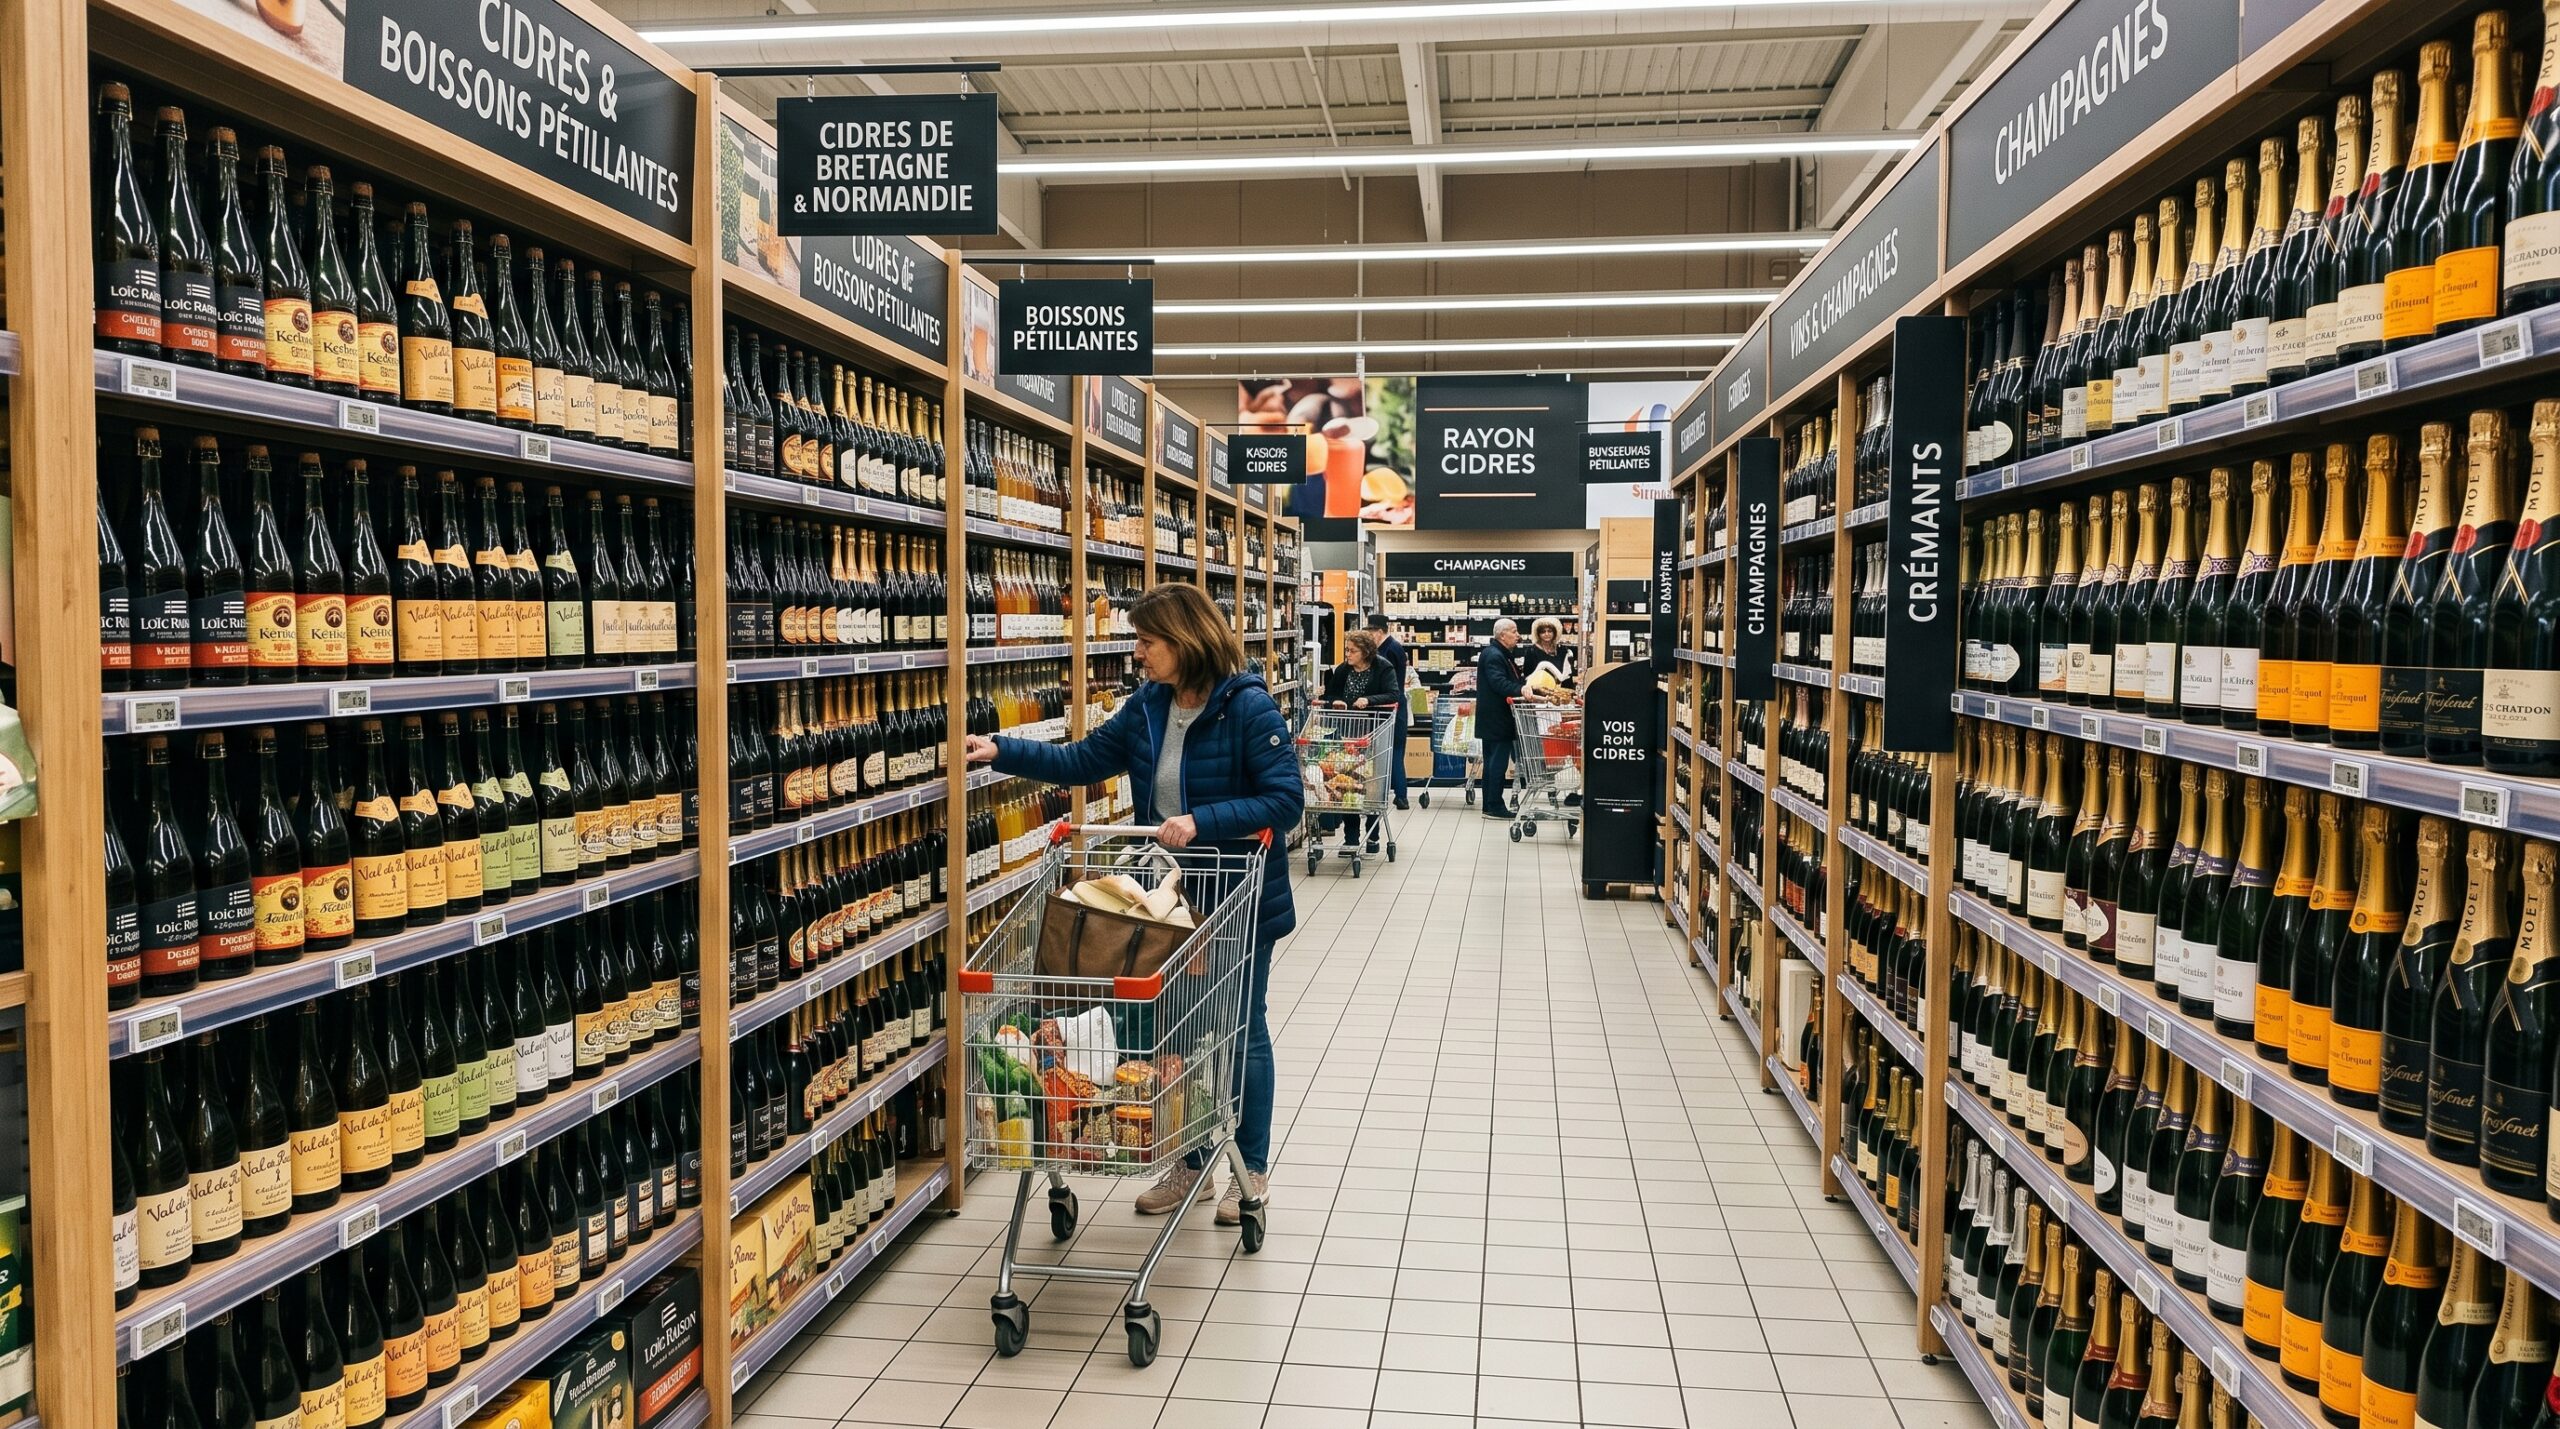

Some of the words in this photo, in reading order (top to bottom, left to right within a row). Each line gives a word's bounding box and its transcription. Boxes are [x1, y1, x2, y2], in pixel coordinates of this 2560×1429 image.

[478, 0, 591, 105] CIDRES
[598, 63, 619, 123] &
[1994, 0, 2169, 185] CHAMPAGNES
[380, 15, 532, 139] BOISSONS
[538, 101, 679, 213] PÉTILLANTES
[819, 122, 912, 150] CIDRES
[920, 120, 954, 147] DE
[817, 152, 949, 181] BRETAGNE
[793, 194, 808, 213] &
[813, 184, 973, 213] NORMANDIE
[852, 236, 900, 286] CIDRES
[813, 251, 875, 314] BOISSONS
[877, 286, 941, 346] PÉTILLANTES
[1790, 309, 1811, 360] VINS
[1810, 301, 1820, 342] &
[1820, 227, 1899, 334] CHAMPAGNES
[1026, 305, 1125, 327] BOISSONS
[1013, 328, 1139, 352] PÉTILLANTES
[1443, 427, 1534, 449] RAYON
[1246, 461, 1288, 473] CIDRES
[1441, 453, 1536, 475] CIDRES
[1901, 442, 1942, 622] CRÉMANTS
[1433, 559, 1526, 571] CHAMPAGNES
[1748, 502, 1767, 635] CHAMPAGNES
[1602, 720, 1635, 733] VOIS
[1592, 747, 1646, 761] CIDRES
[2519, 894, 2539, 950] MOET
